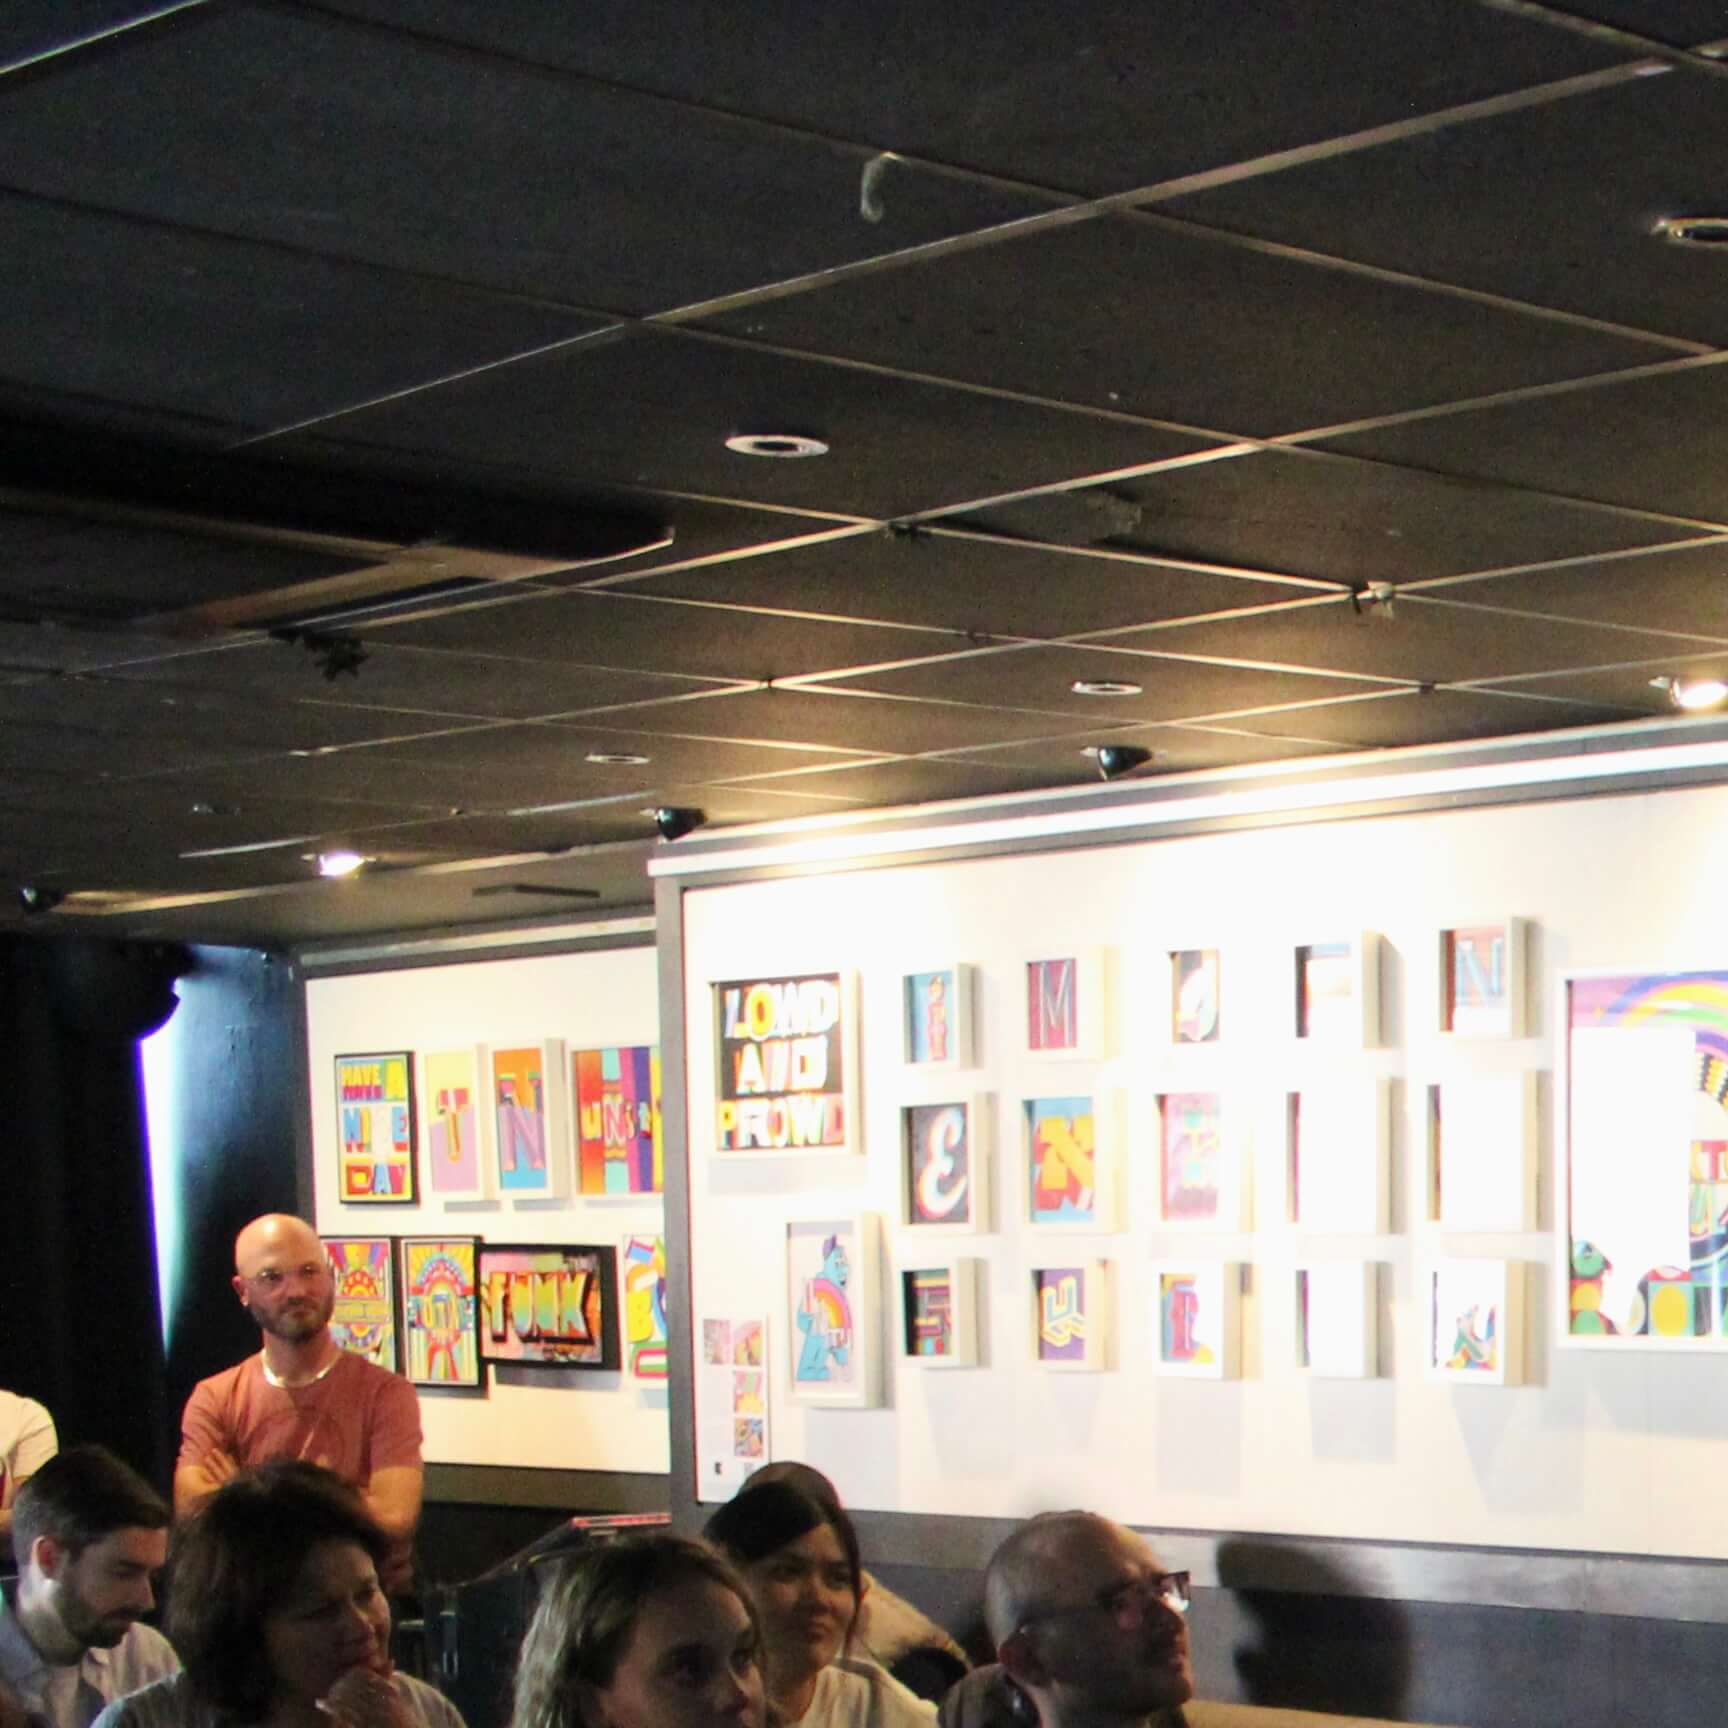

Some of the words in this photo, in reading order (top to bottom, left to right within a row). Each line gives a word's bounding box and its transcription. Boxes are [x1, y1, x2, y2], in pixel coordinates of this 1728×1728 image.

[341, 1063, 383, 1099] HAVE
[343, 1105, 409, 1152] NIE
[346, 1158, 407, 1196] DAY
